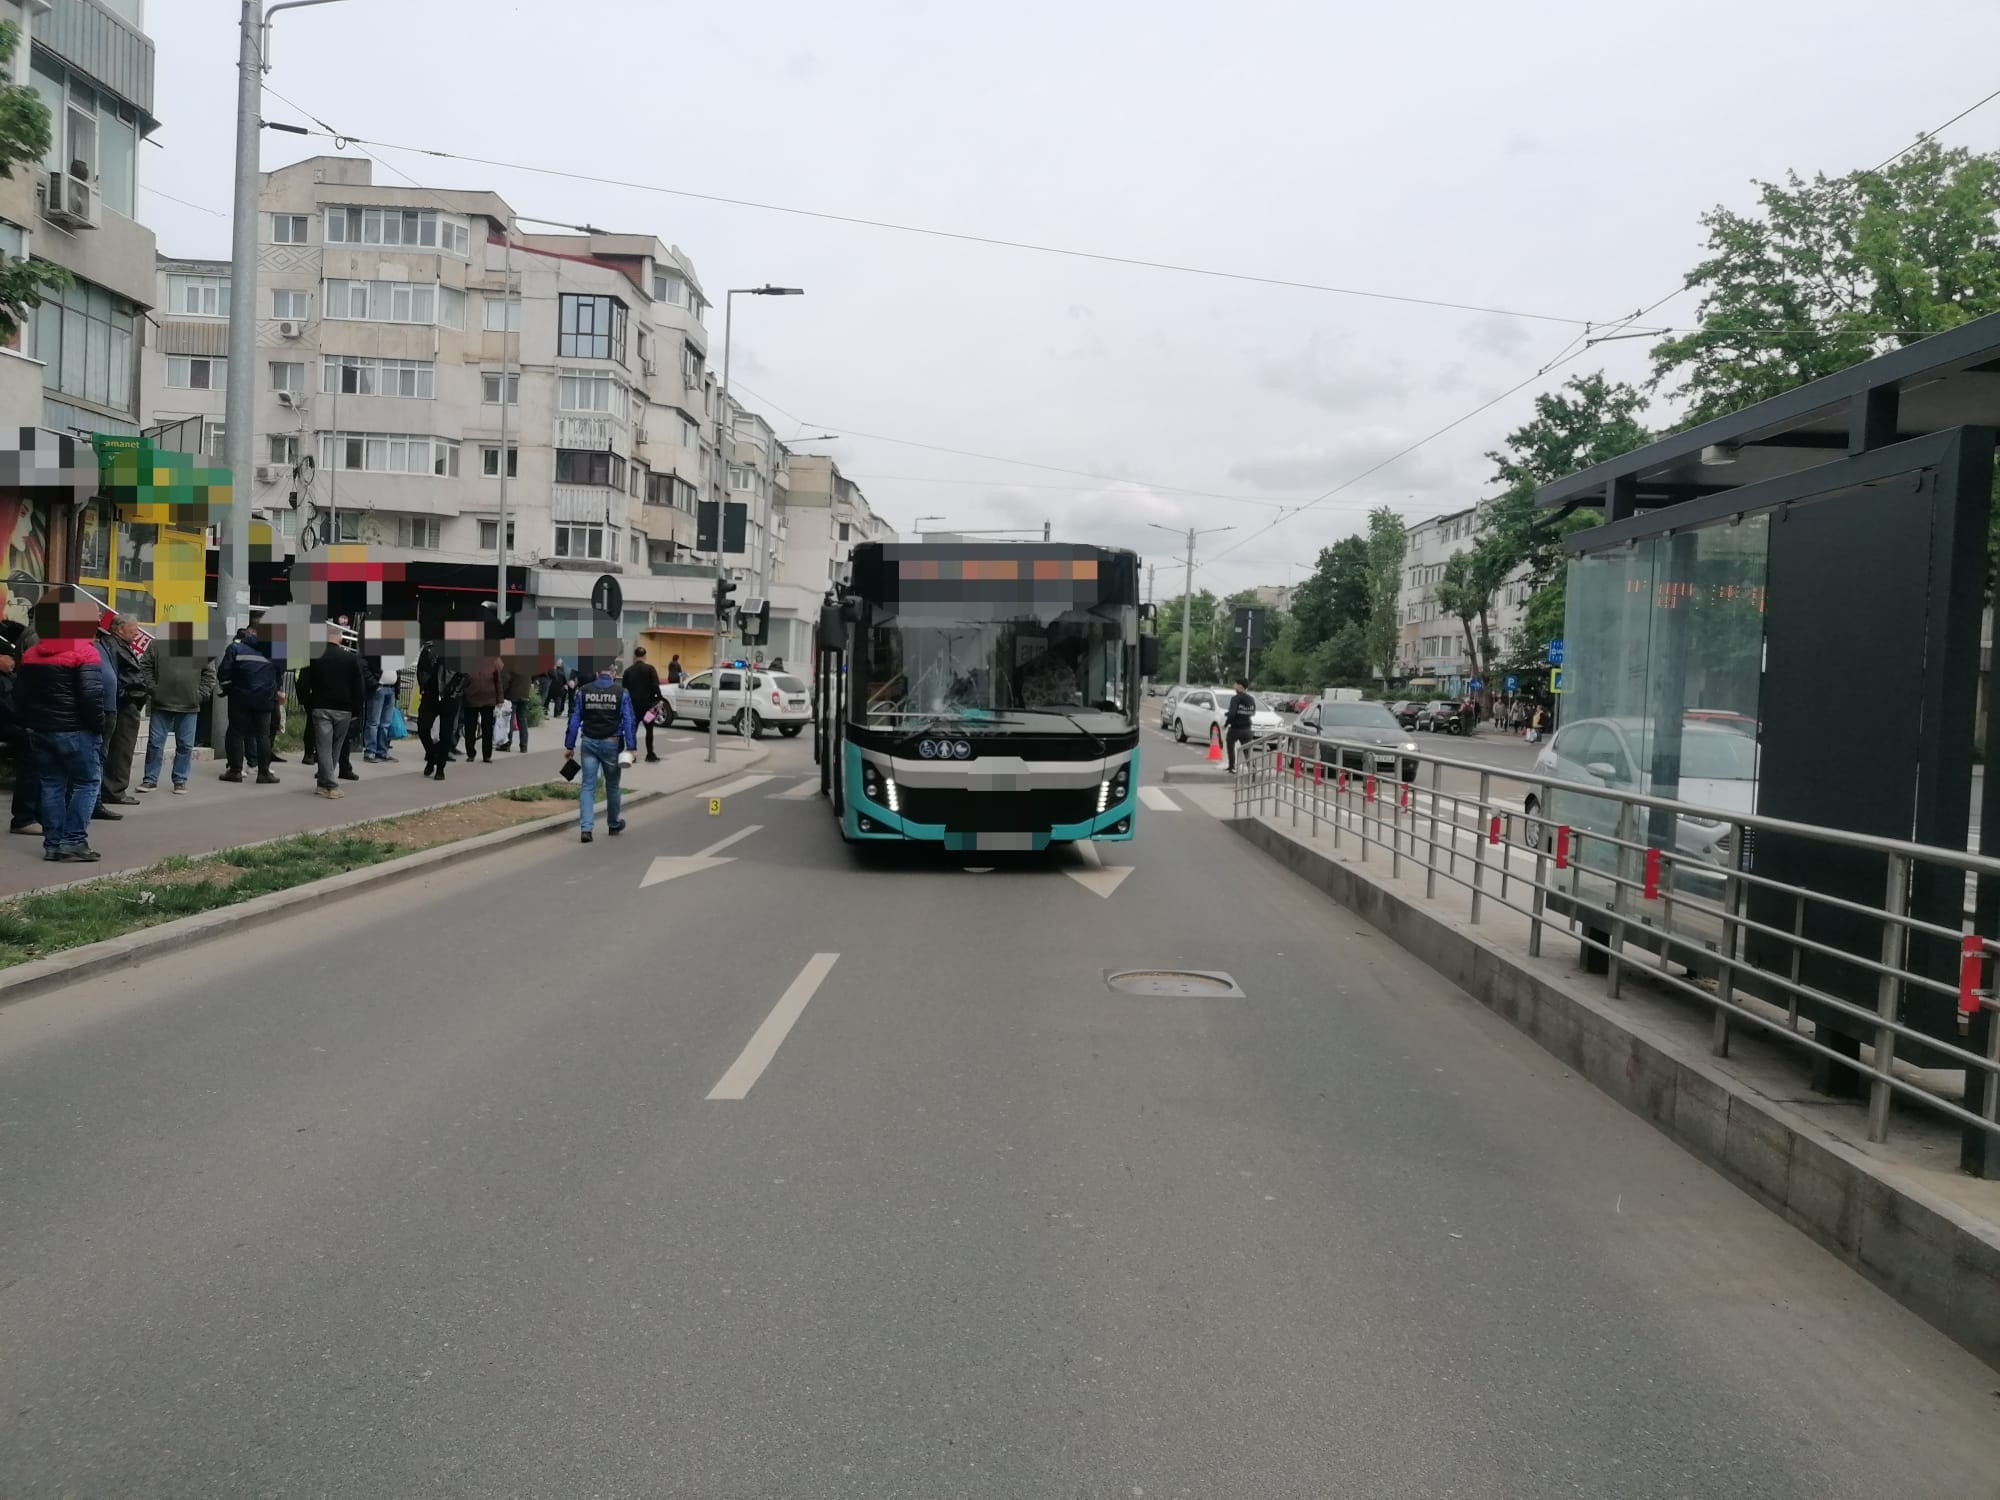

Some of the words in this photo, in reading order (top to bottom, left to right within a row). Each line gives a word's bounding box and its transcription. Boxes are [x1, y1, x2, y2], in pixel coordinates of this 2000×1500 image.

[104, 440, 140, 448] amanet
[1508, 678, 1515, 687] P
[585, 693, 617, 703] POLITIA
[711, 800, 718, 811] 3
